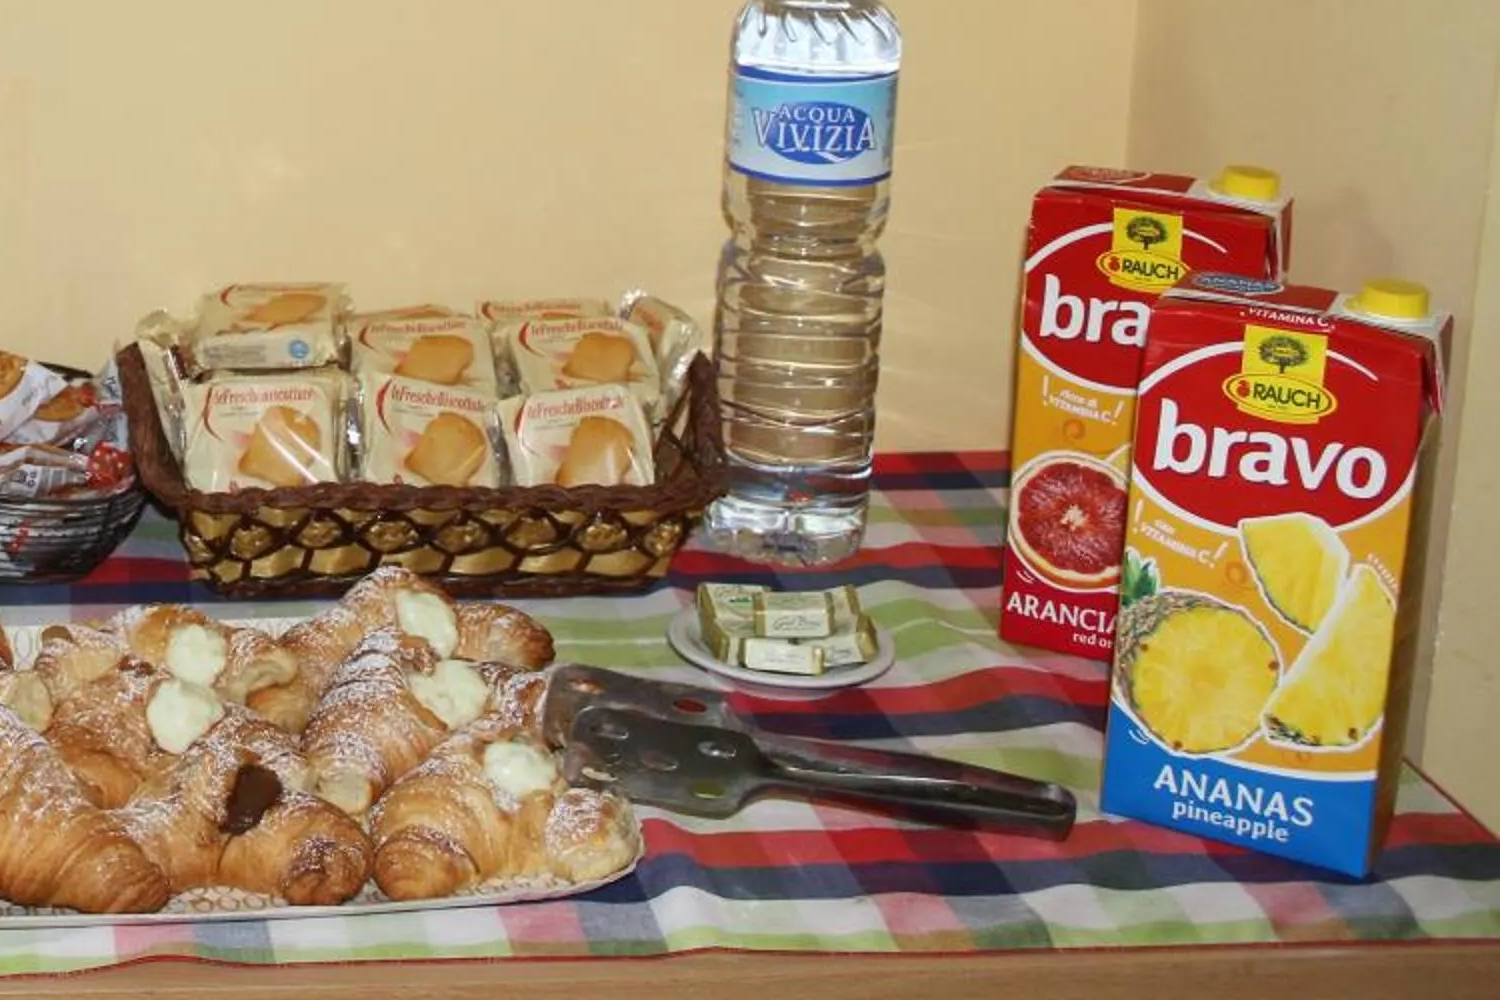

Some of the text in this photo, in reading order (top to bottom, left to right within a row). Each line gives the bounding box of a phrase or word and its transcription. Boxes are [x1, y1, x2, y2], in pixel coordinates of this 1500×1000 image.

[752, 107, 878, 151] VIVIZIA
[778, 104, 856, 123] ACQUA
[1120, 258, 1180, 281] RAUCH
[1252, 382, 1321, 410] RAUCH
[1153, 397, 1388, 499] bravo
[1072, 632, 1097, 646] red
[1153, 764, 1314, 827] ANANAS
[1171, 800, 1290, 844] pineapple
